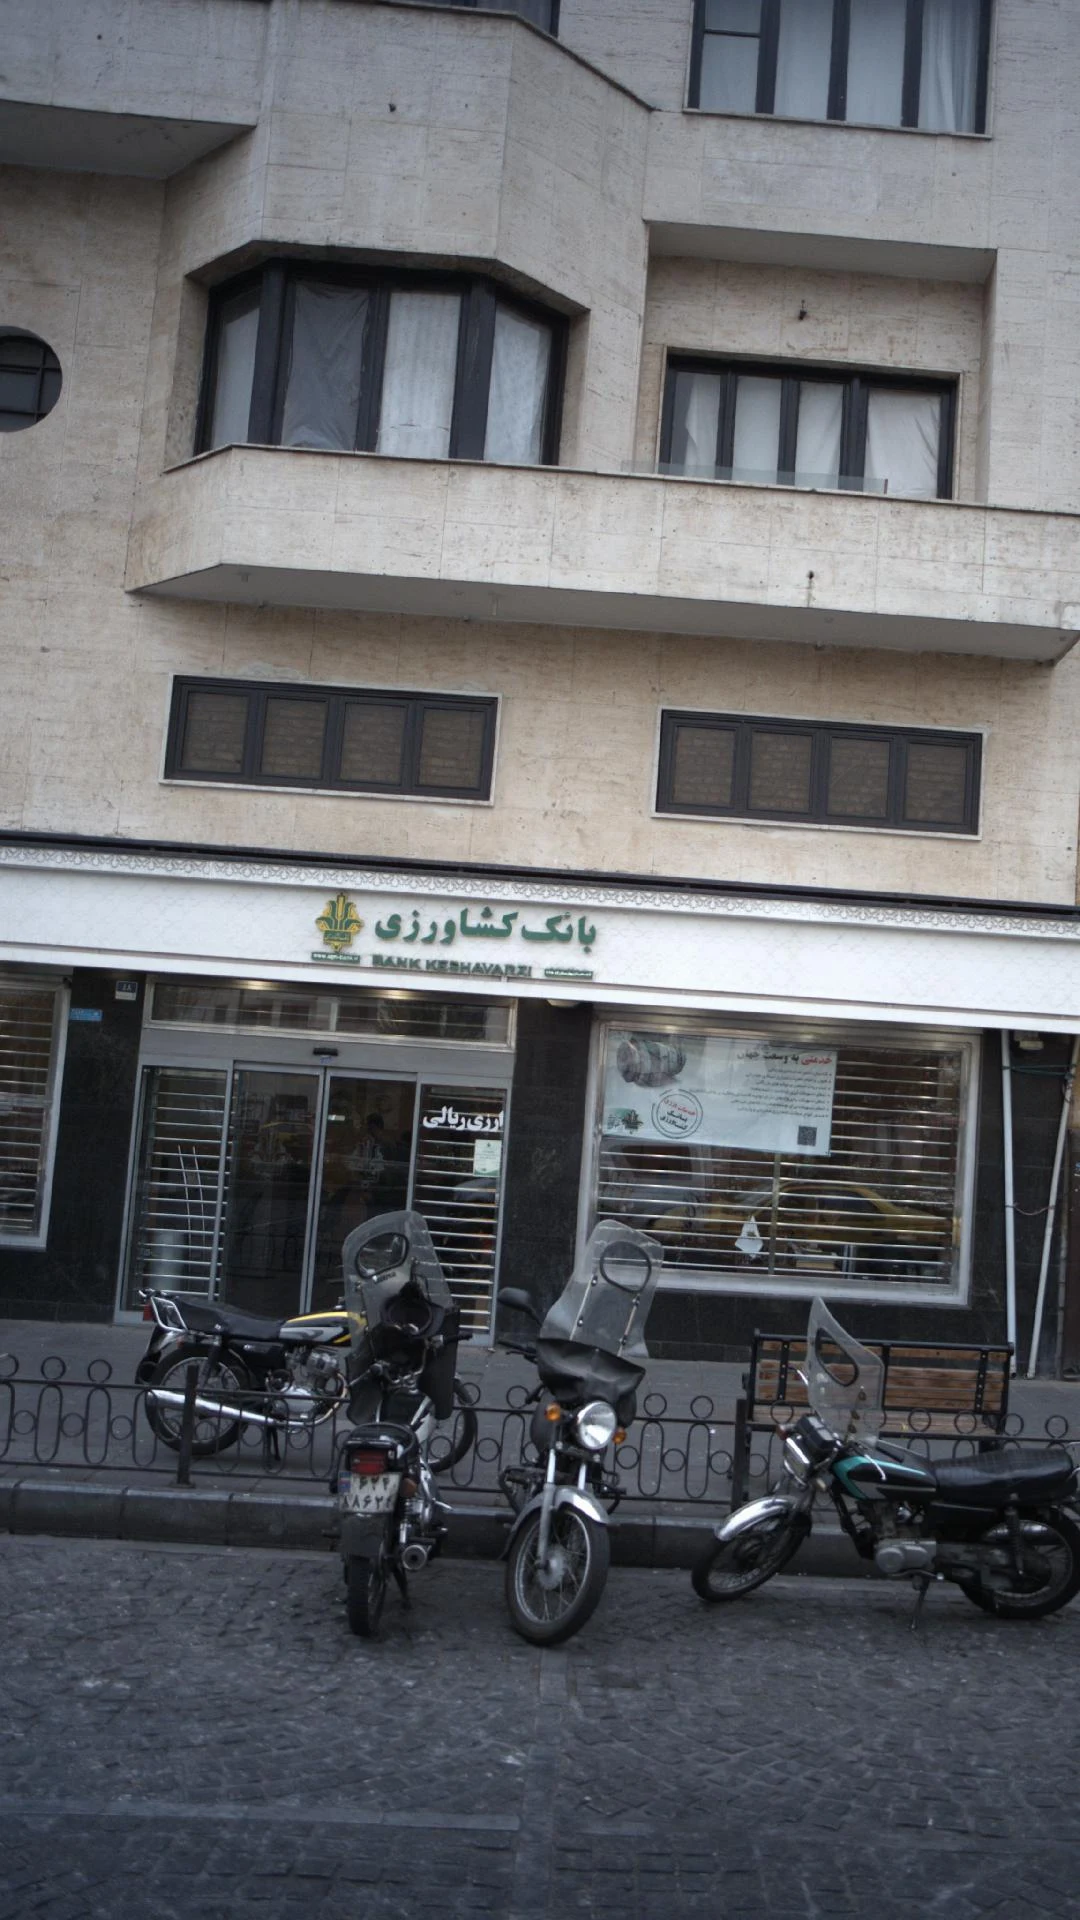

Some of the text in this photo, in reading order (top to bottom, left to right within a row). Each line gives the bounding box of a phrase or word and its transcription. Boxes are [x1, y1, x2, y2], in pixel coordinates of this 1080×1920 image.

[374, 906, 597, 954] بانک کشاورزی
[372, 954, 421, 970] BANK
[425, 959, 533, 977] KESHAVARZI
[422, 1105, 504, 1131] ارزی ریالی
